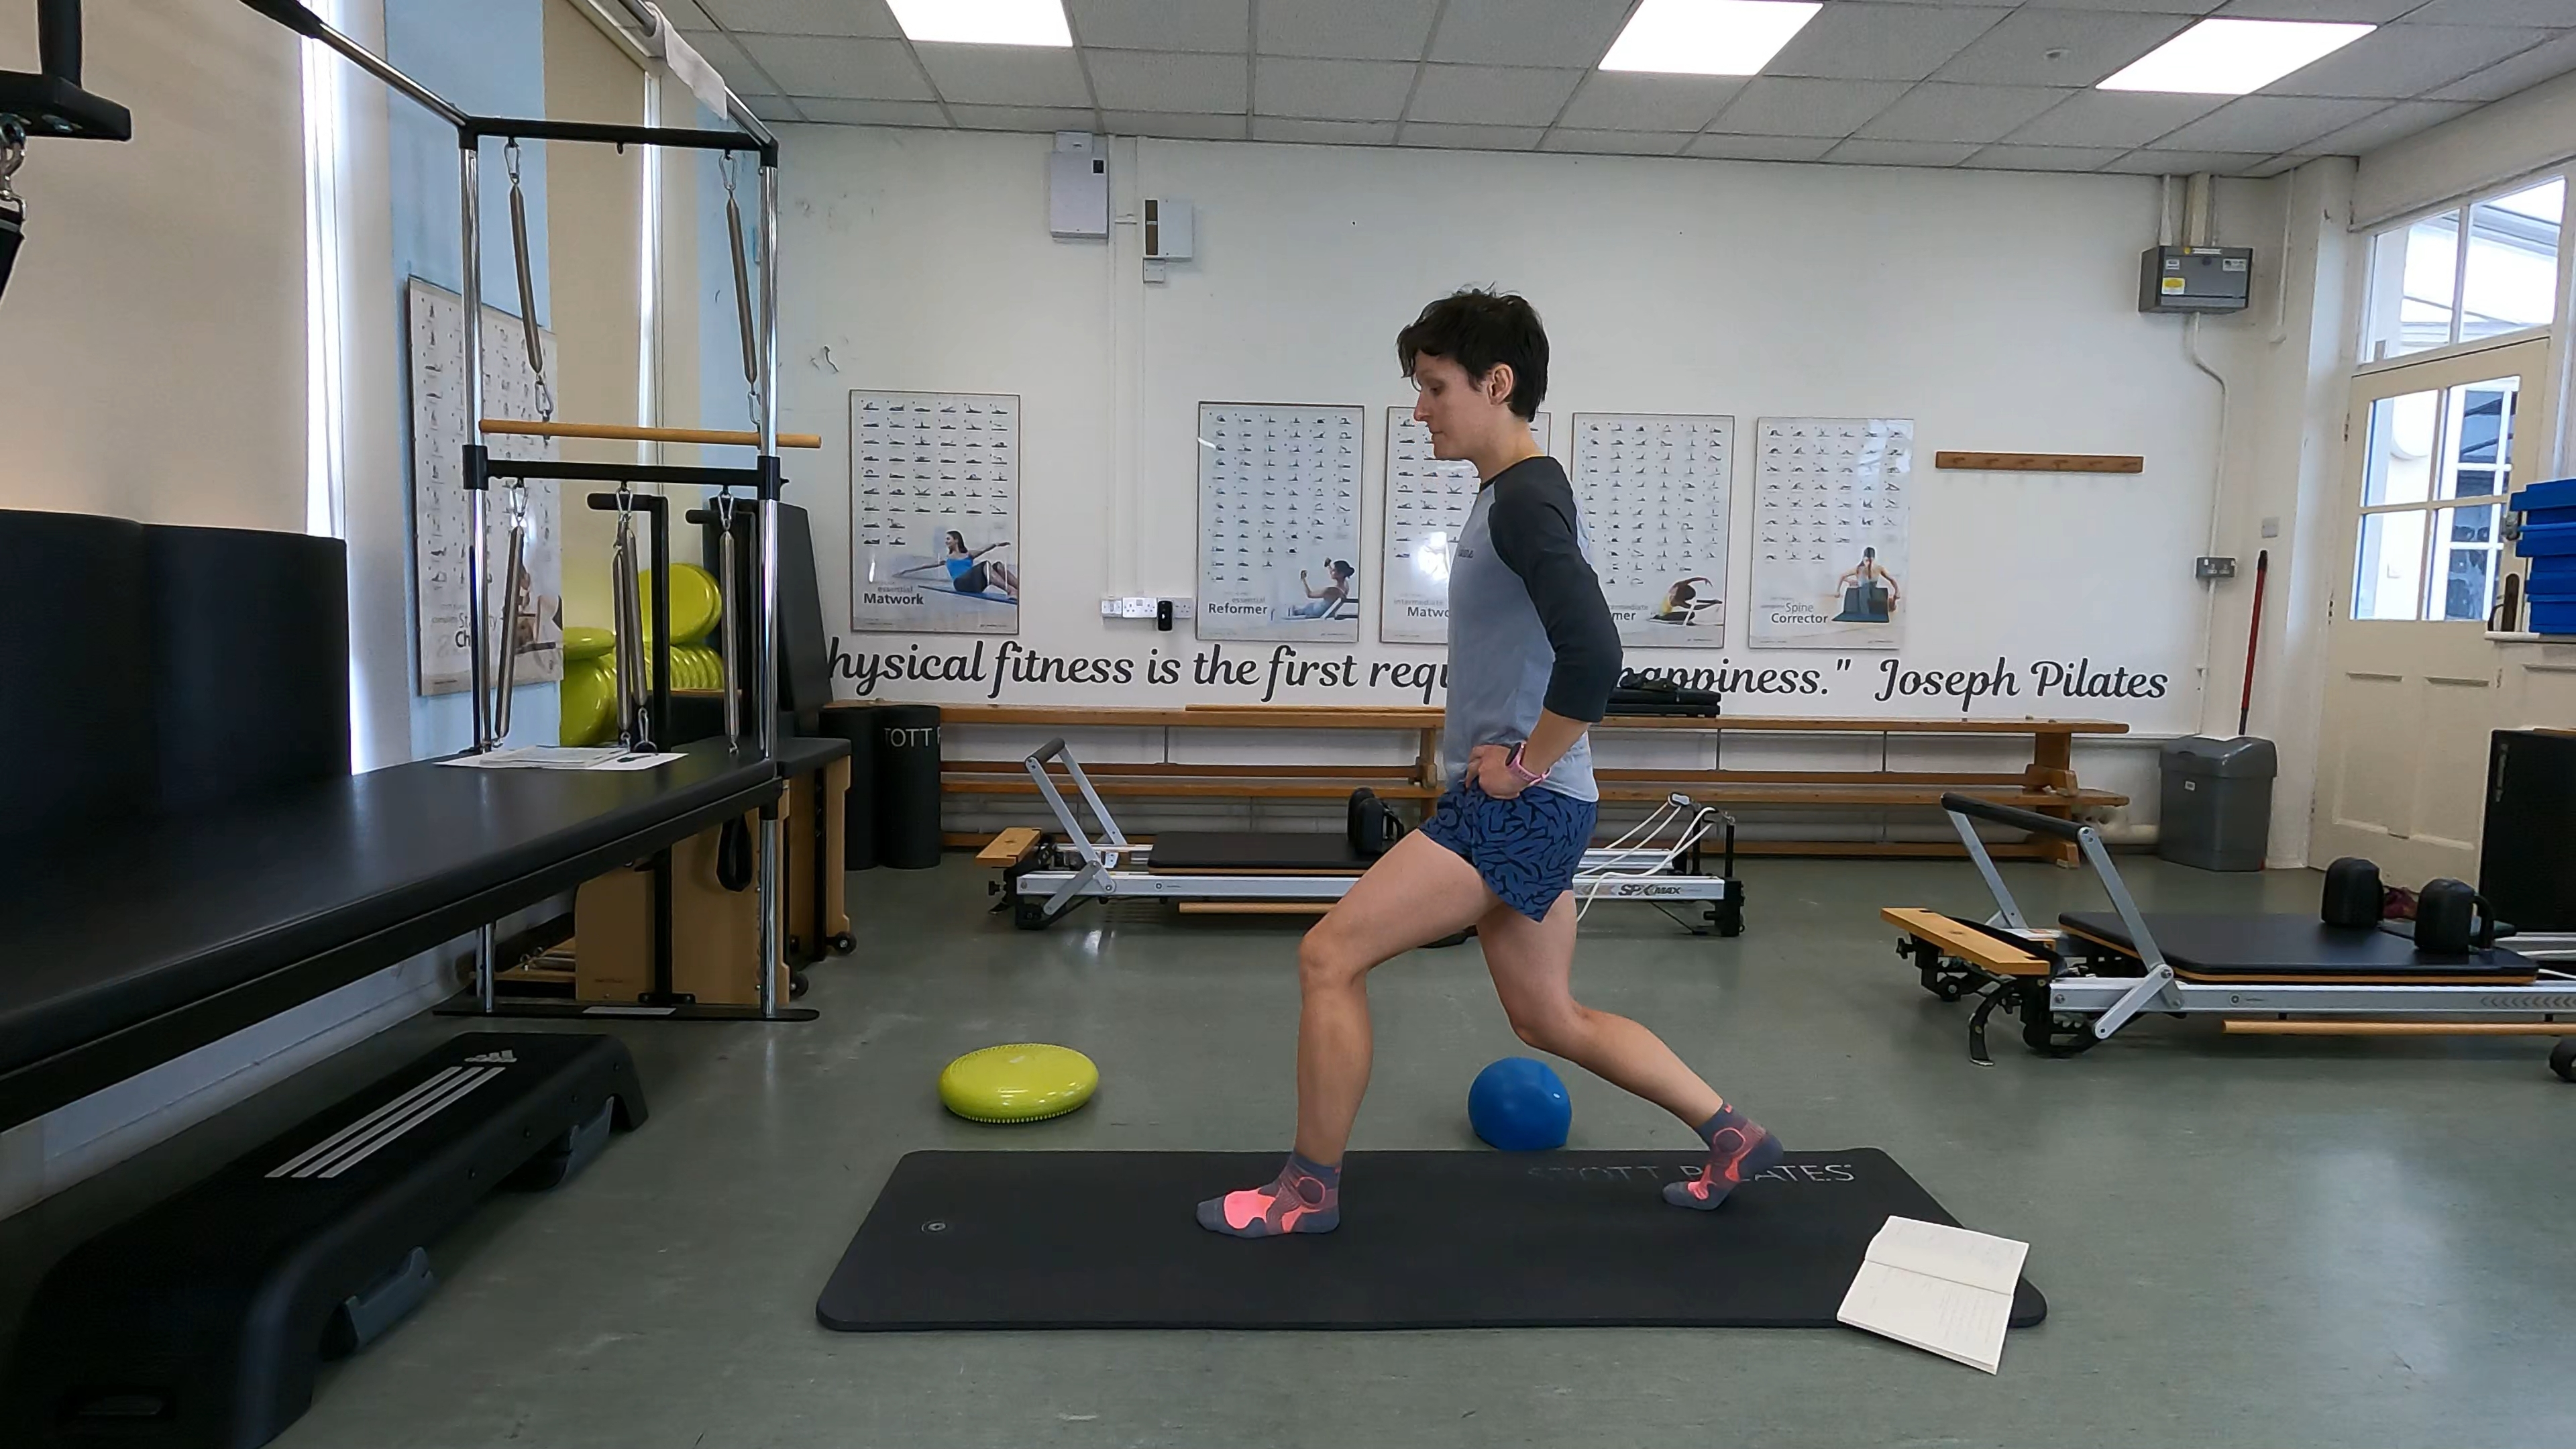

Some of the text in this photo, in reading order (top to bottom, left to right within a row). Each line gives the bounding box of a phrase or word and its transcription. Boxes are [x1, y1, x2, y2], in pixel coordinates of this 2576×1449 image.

[863, 592, 924, 605] Matwork
[1208, 604, 1268, 614] Reformer
[1785, 602, 1814, 614] Spine
[1771, 612, 1829, 624] Corrector
[987, 640, 1134, 699] fitness
[1147, 649, 1181, 684] is
[1193, 644, 1260, 685] the
[1260, 645, 1358, 702] first
[1874, 656, 2021, 712] Joseph
[2031, 657, 2169, 698] Pilates
